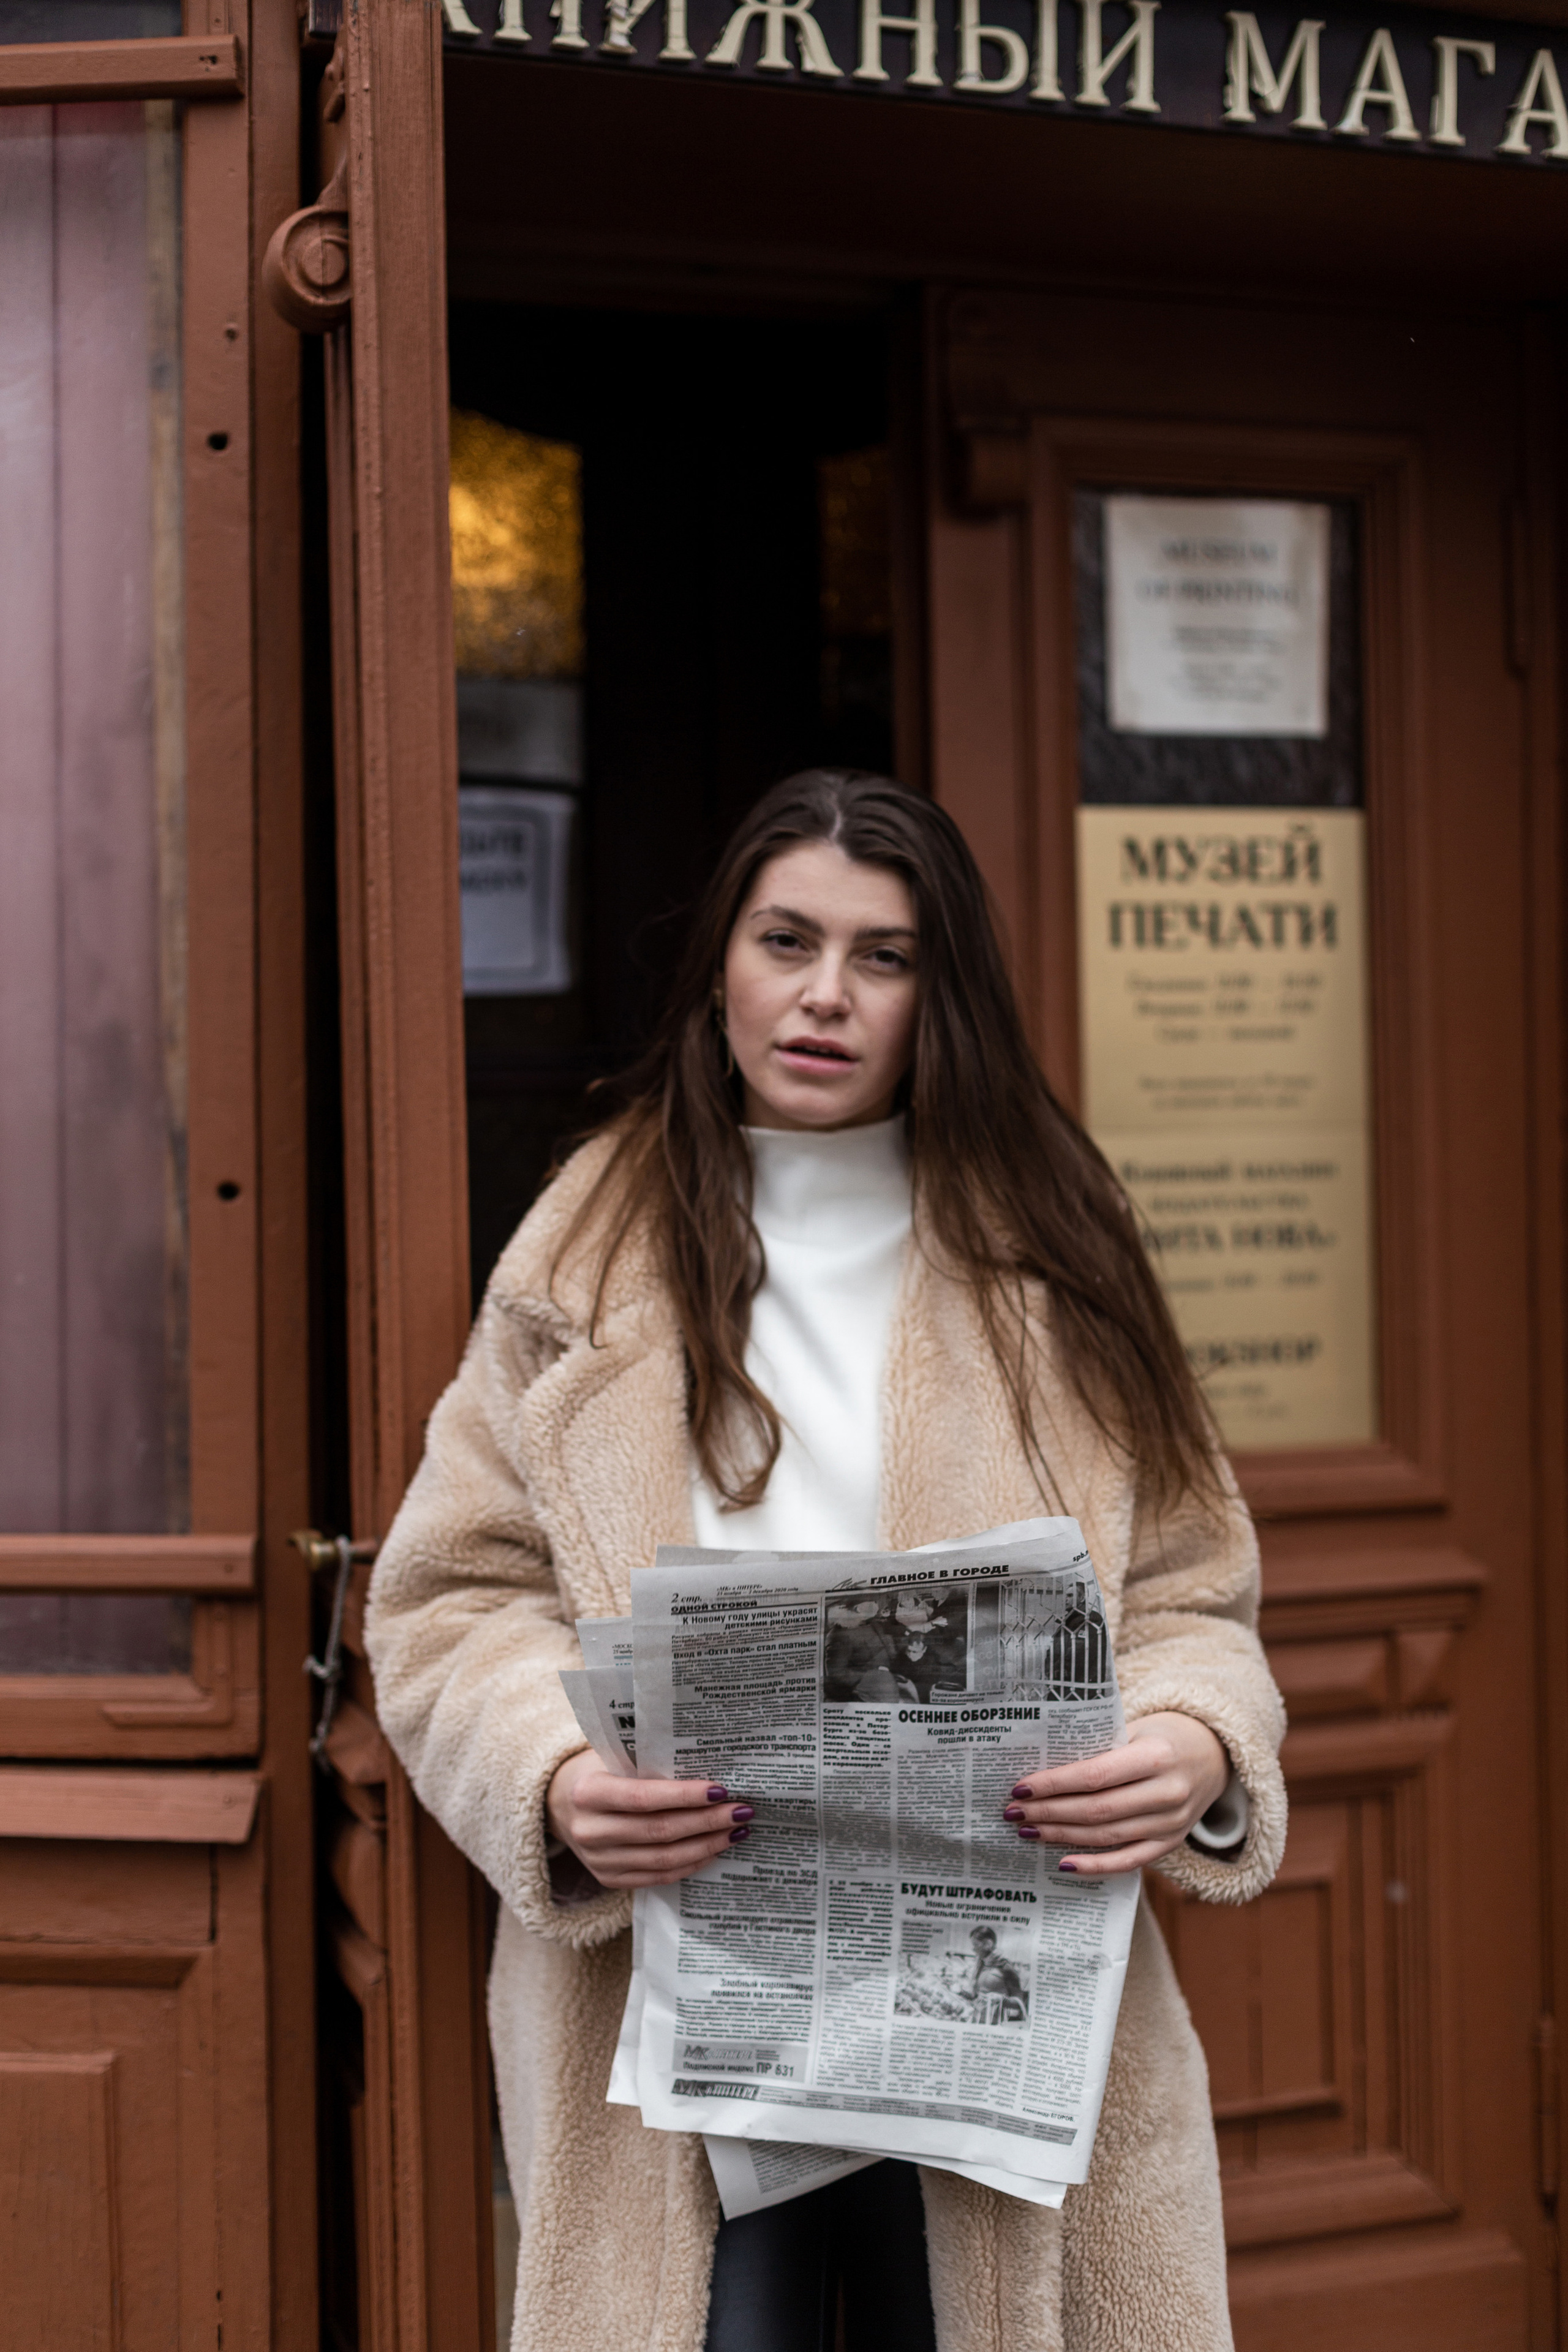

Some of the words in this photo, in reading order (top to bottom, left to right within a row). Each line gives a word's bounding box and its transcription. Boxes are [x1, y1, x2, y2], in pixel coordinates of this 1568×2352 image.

[1120, 820, 1323, 886] МУЗЕЙ
[1107, 900, 1339, 951] ПЕЧАТИ
[870, 1571, 935, 1585] ГЛАВНОЕ
[953, 1564, 1009, 1577] ГОРОДЕ
[671, 1593, 679, 1603] 2
[752, 1611, 780, 1620] улицы
[783, 1607, 818, 1618] украсят
[725, 1620, 767, 1630] детскими
[770, 1616, 818, 1626] рисунками
[695, 1684, 741, 1692] Манежная
[786, 1678, 816, 1686] против
[703, 1687, 777, 1699] Рождественской
[779, 1686, 816, 1694] ярмарки
[609, 1700, 616, 1709] 4
[898, 1709, 957, 1723] ОСЕННЕЕ
[960, 1707, 1041, 1722] ОБОРЗЕНИЕ
[927, 1726, 1011, 1736] Ковид-диссиденты
[696, 1736, 742, 1746] Смольный
[938, 1736, 967, 1744] пошли
[976, 1735, 1001, 1744] атаку
[676, 1747, 721, 1755] маршрутов
[723, 1744, 769, 1752] городского
[721, 1872, 772, 1882] подорожает
[753, 1866, 785, 1876] Проезд
[799, 1869, 818, 1879] ЗСД
[902, 1883, 944, 1898] БУДУТ
[946, 1885, 1037, 1903] ШТРАФОВАТЬ
[925, 1901, 954, 1909] Новые
[956, 1902, 1012, 1913] ограничения
[680, 1909, 720, 1920] Смольный
[906, 1909, 959, 1918] официально
[962, 1912, 1000, 1921] вступили
[1010, 1916, 1030, 1926] силу
